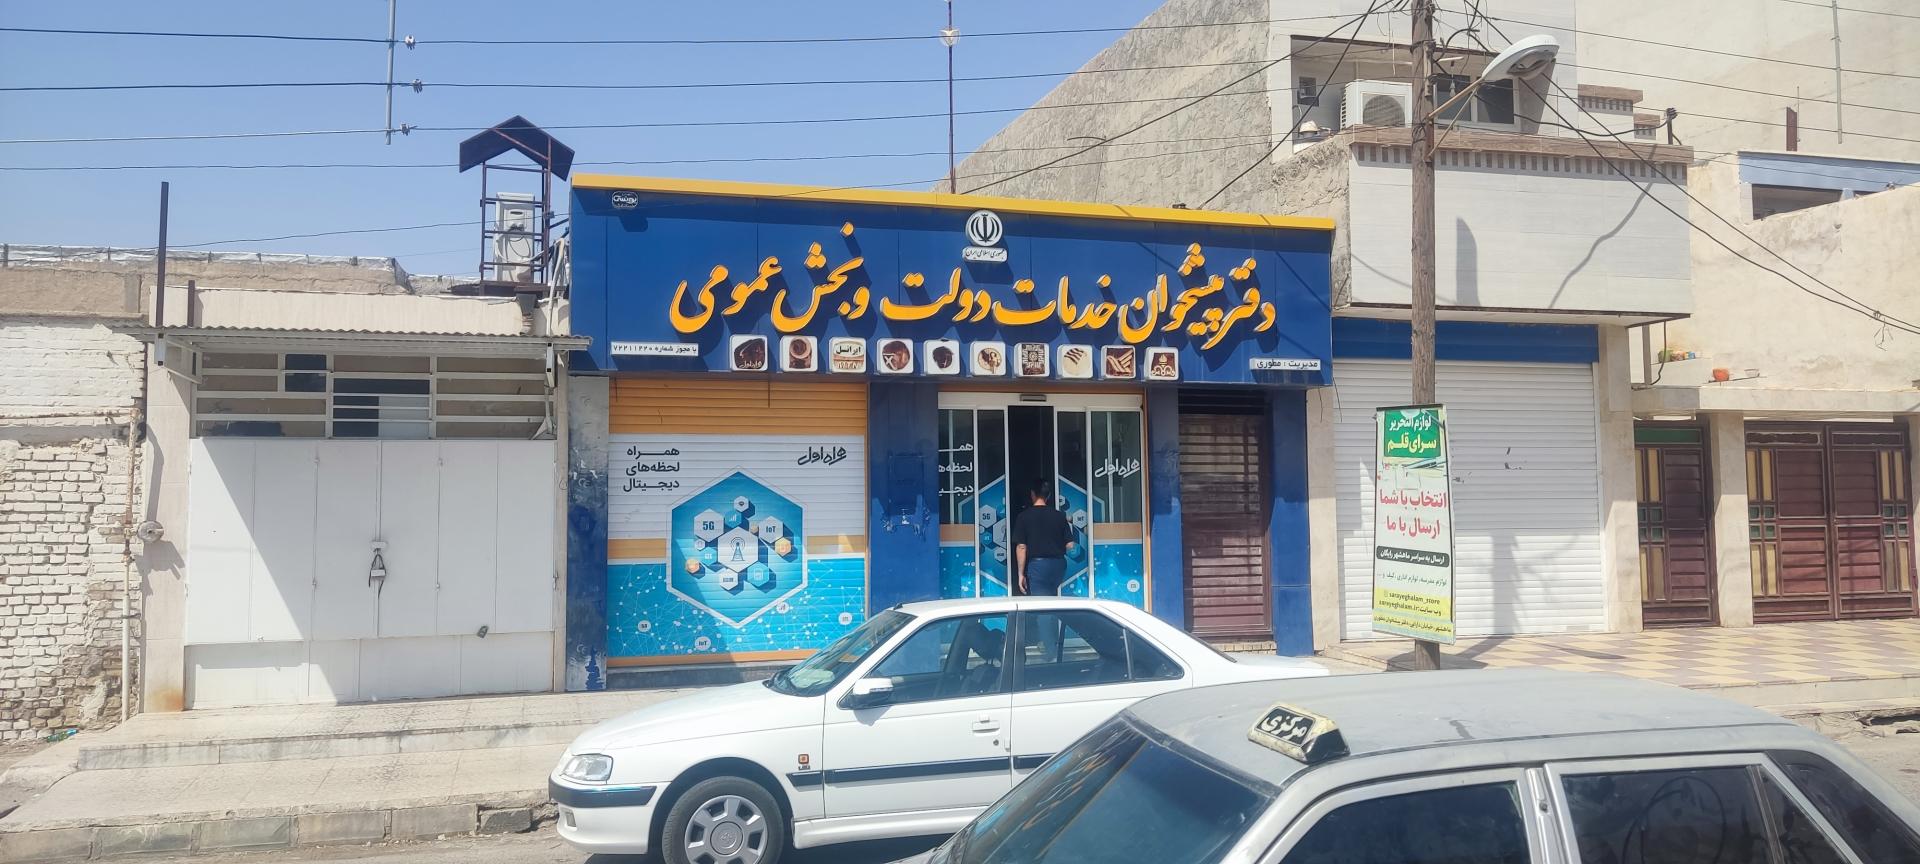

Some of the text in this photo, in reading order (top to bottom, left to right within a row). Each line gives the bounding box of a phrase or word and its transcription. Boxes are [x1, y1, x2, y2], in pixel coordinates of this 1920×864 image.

[770, 221, 864, 333] بخش
[669, 255, 783, 334] عمومی
[879, 266, 992, 323] دولت
[992, 274, 1118, 331] خدمات
[1118, 242, 1225, 344] پیشخوان
[1201, 257, 1276, 350] دفتر
[835, 345, 861, 355] ایرانسل
[1413, 414, 1432, 432] لوازم
[625, 445, 680, 460] همراه
[1387, 431, 1437, 454] سرای قلم
[622, 478, 680, 493] دیجیتال
[1379, 488, 1447, 510] انتخاب با شما
[702, 520, 715, 531] 5G
[765, 525, 776, 533] IoT
[1386, 515, 1441, 539] ارسال با ما
[1431, 555, 1445, 565] ارسال
[1260, 714, 1308, 741] مرکزی
